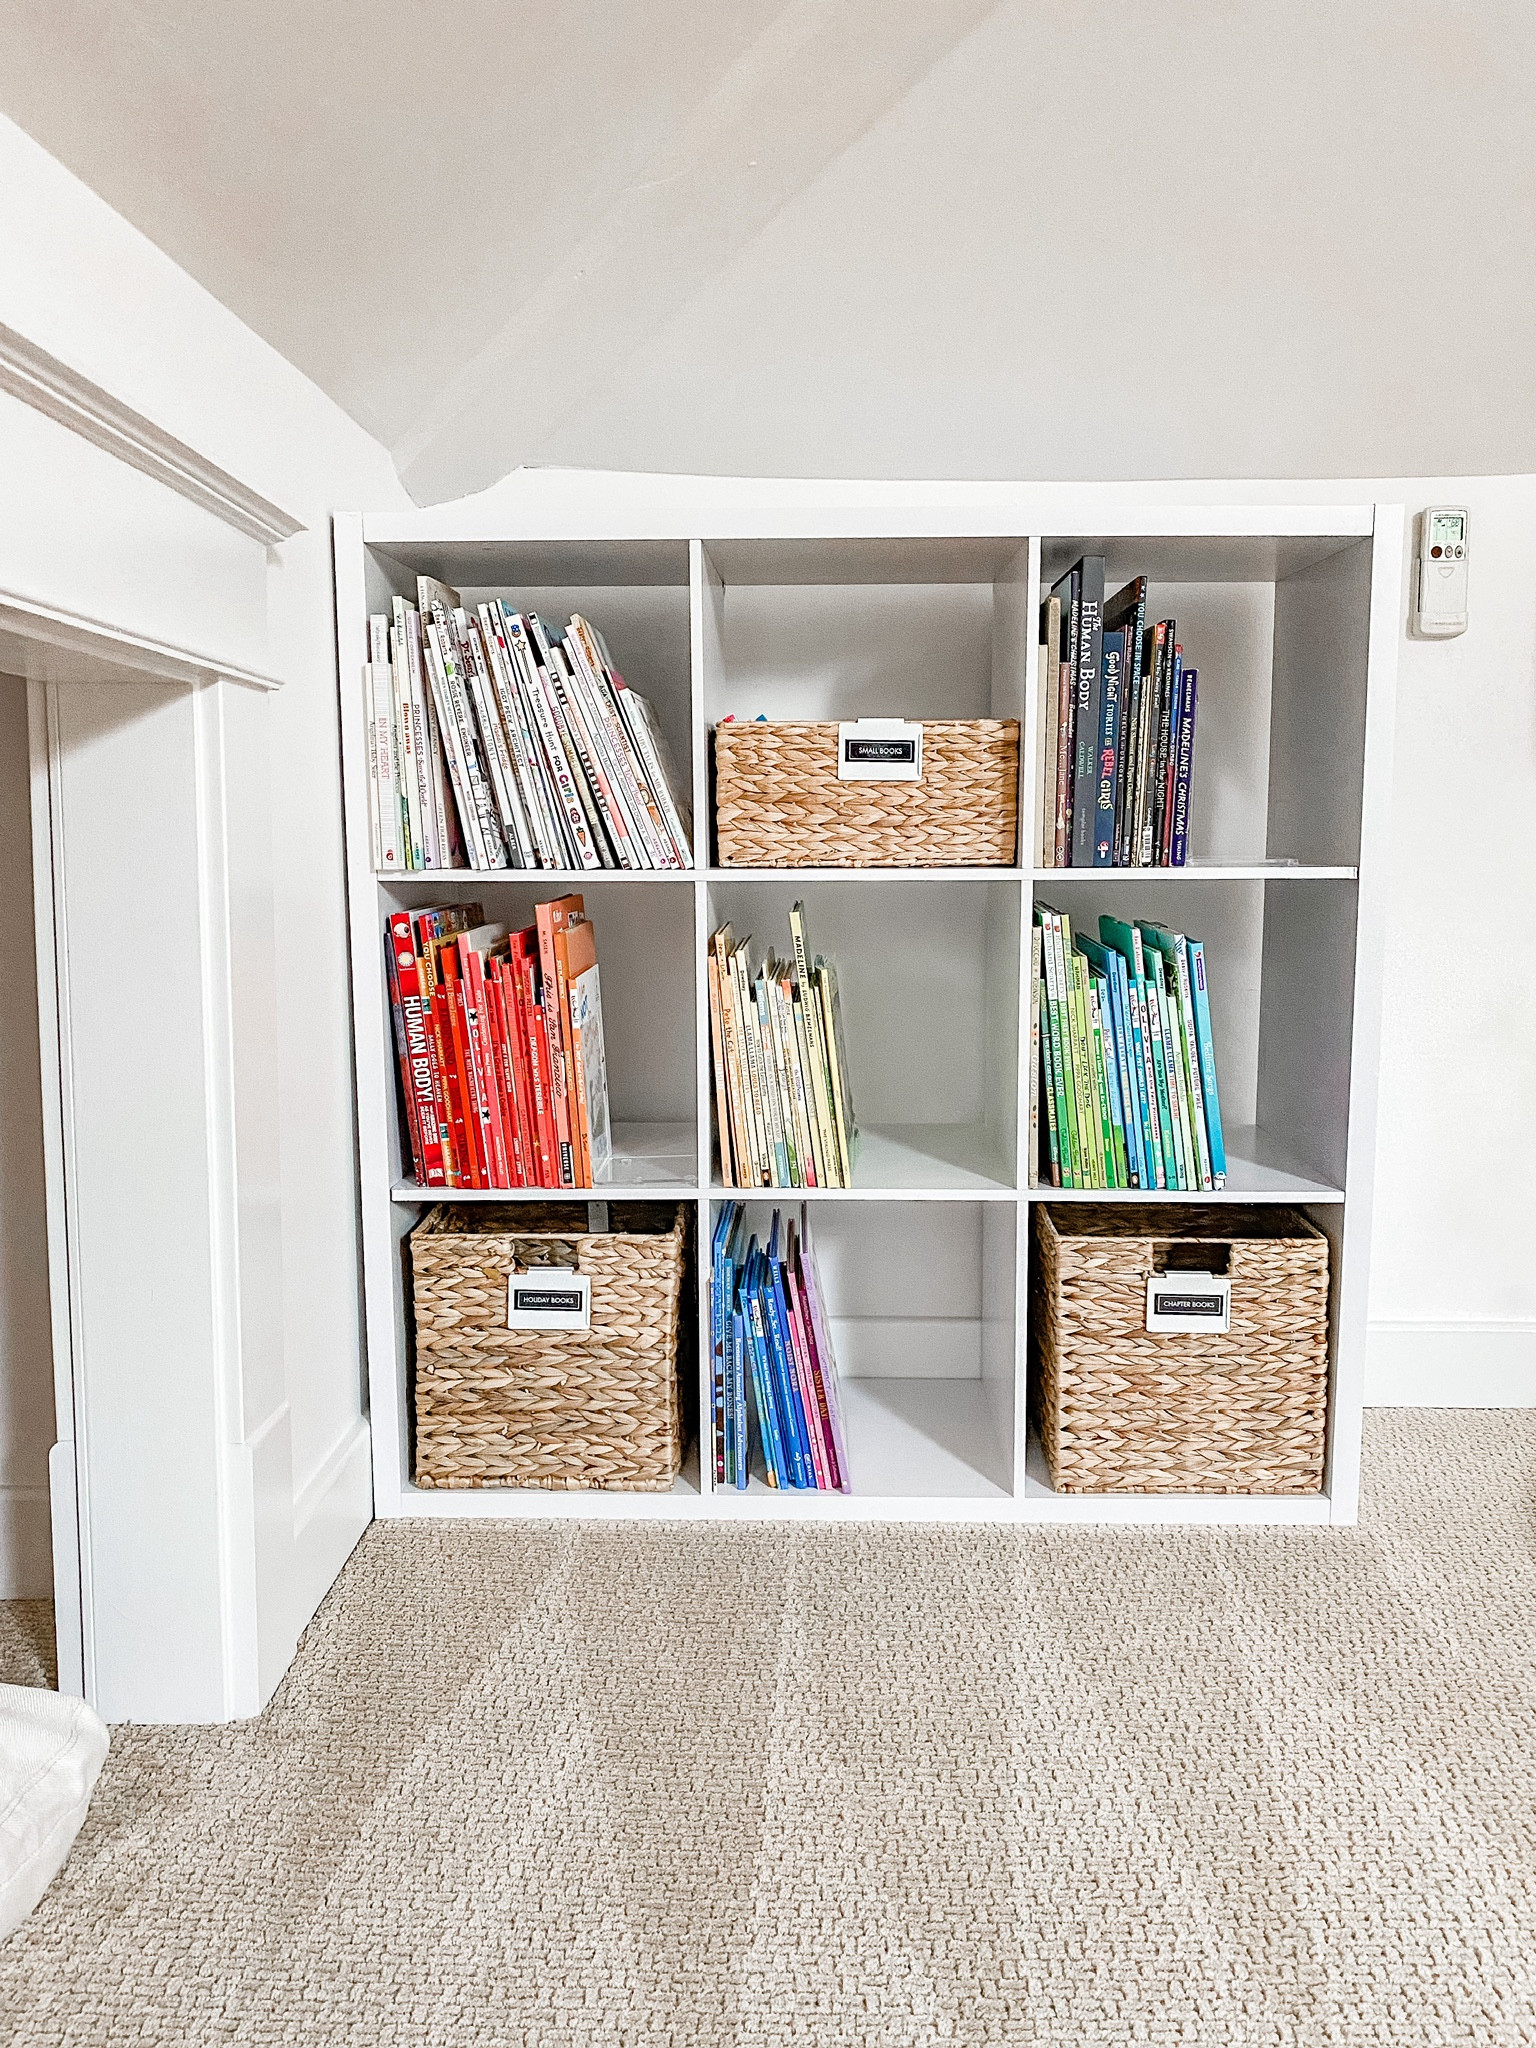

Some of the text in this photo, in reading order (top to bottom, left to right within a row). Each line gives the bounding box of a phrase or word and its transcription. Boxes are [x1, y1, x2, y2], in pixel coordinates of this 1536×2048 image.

[1078, 600, 1102, 710] The HUMAN BODY
[1132, 602, 1146, 686] YOU CHOOSE IN SPACE
[1070, 644, 1078, 686] CHRISTMAS
[1185, 674, 1193, 713] BEMELMANS
[414, 704, 424, 756] PRINCESSES
[450, 680, 459, 698] ROSIE
[460, 727, 472, 756] ENGINEER
[500, 688, 524, 767] IGGY ARCHITECT
[532, 687, 548, 728] Treasure
[545, 732, 557, 751] Hunt
[552, 756, 563, 772] FOR
[552, 706, 568, 738] GOODBYE
[600, 685, 631, 753] ADA SCIENTIST
[1105, 704, 1114, 736] STORIES
[1162, 710, 1170, 728] THE
[379, 718, 390, 779] IN MY HEART
[858, 746, 878, 754] SMALL
[1078, 742, 1086, 778] CALDWELL
[1160, 729, 1169, 758] HOUSE
[1179, 717, 1192, 779] MADELINE'S
[1101, 748, 1114, 779] REBEL
[1118, 750, 1126, 784] UNICORN
[1098, 780, 1114, 810] GIRLS
[1156, 782, 1165, 810] NIGHT
[1176, 782, 1187, 836] CHRISTMAS
[794, 936, 806, 980] MADELINE
[1046, 932, 1054, 966] Richard
[422, 941, 436, 996] YOU CHOOSE
[544, 972, 553, 999] This
[548, 1001, 554, 1012] is
[802, 989, 810, 1011] LUDWIG
[804, 1014, 815, 1048] BEMELMANS
[1050, 1000, 1064, 1097] BEST WORD BOOK EVER
[1141, 1005, 1152, 1064] OLIVIA
[404, 996, 434, 1102] HUMAN BODY!
[530, 1036, 539, 1066] DRAGON
[552, 1044, 562, 1098] Francisco
[748, 1047, 756, 1069] LLAMA
[754, 1090, 759, 1098] TO
[1158, 1080, 1164, 1088] My
[1166, 1052, 1174, 1074] LLAMA
[1172, 1100, 1180, 1120] SHARE
[1192, 1068, 1200, 1091] FUTURE
[1204, 1041, 1215, 1096] Bedtime Songs
[534, 1084, 544, 1115] TERRIBLE
[1047, 1086, 1056, 1132] CLASSMATES
[1084, 1092, 1092, 1108] DOG
[524, 1296, 550, 1304] HOLIDAY
[1164, 1300, 1190, 1308] CHAPTER
[726, 1341, 732, 1352] ME
[726, 1377, 733, 1389] MY
[784, 1340, 795, 1366] NOISY
[790, 1369, 799, 1392] NORA
[814, 1370, 825, 1400] SISTER
